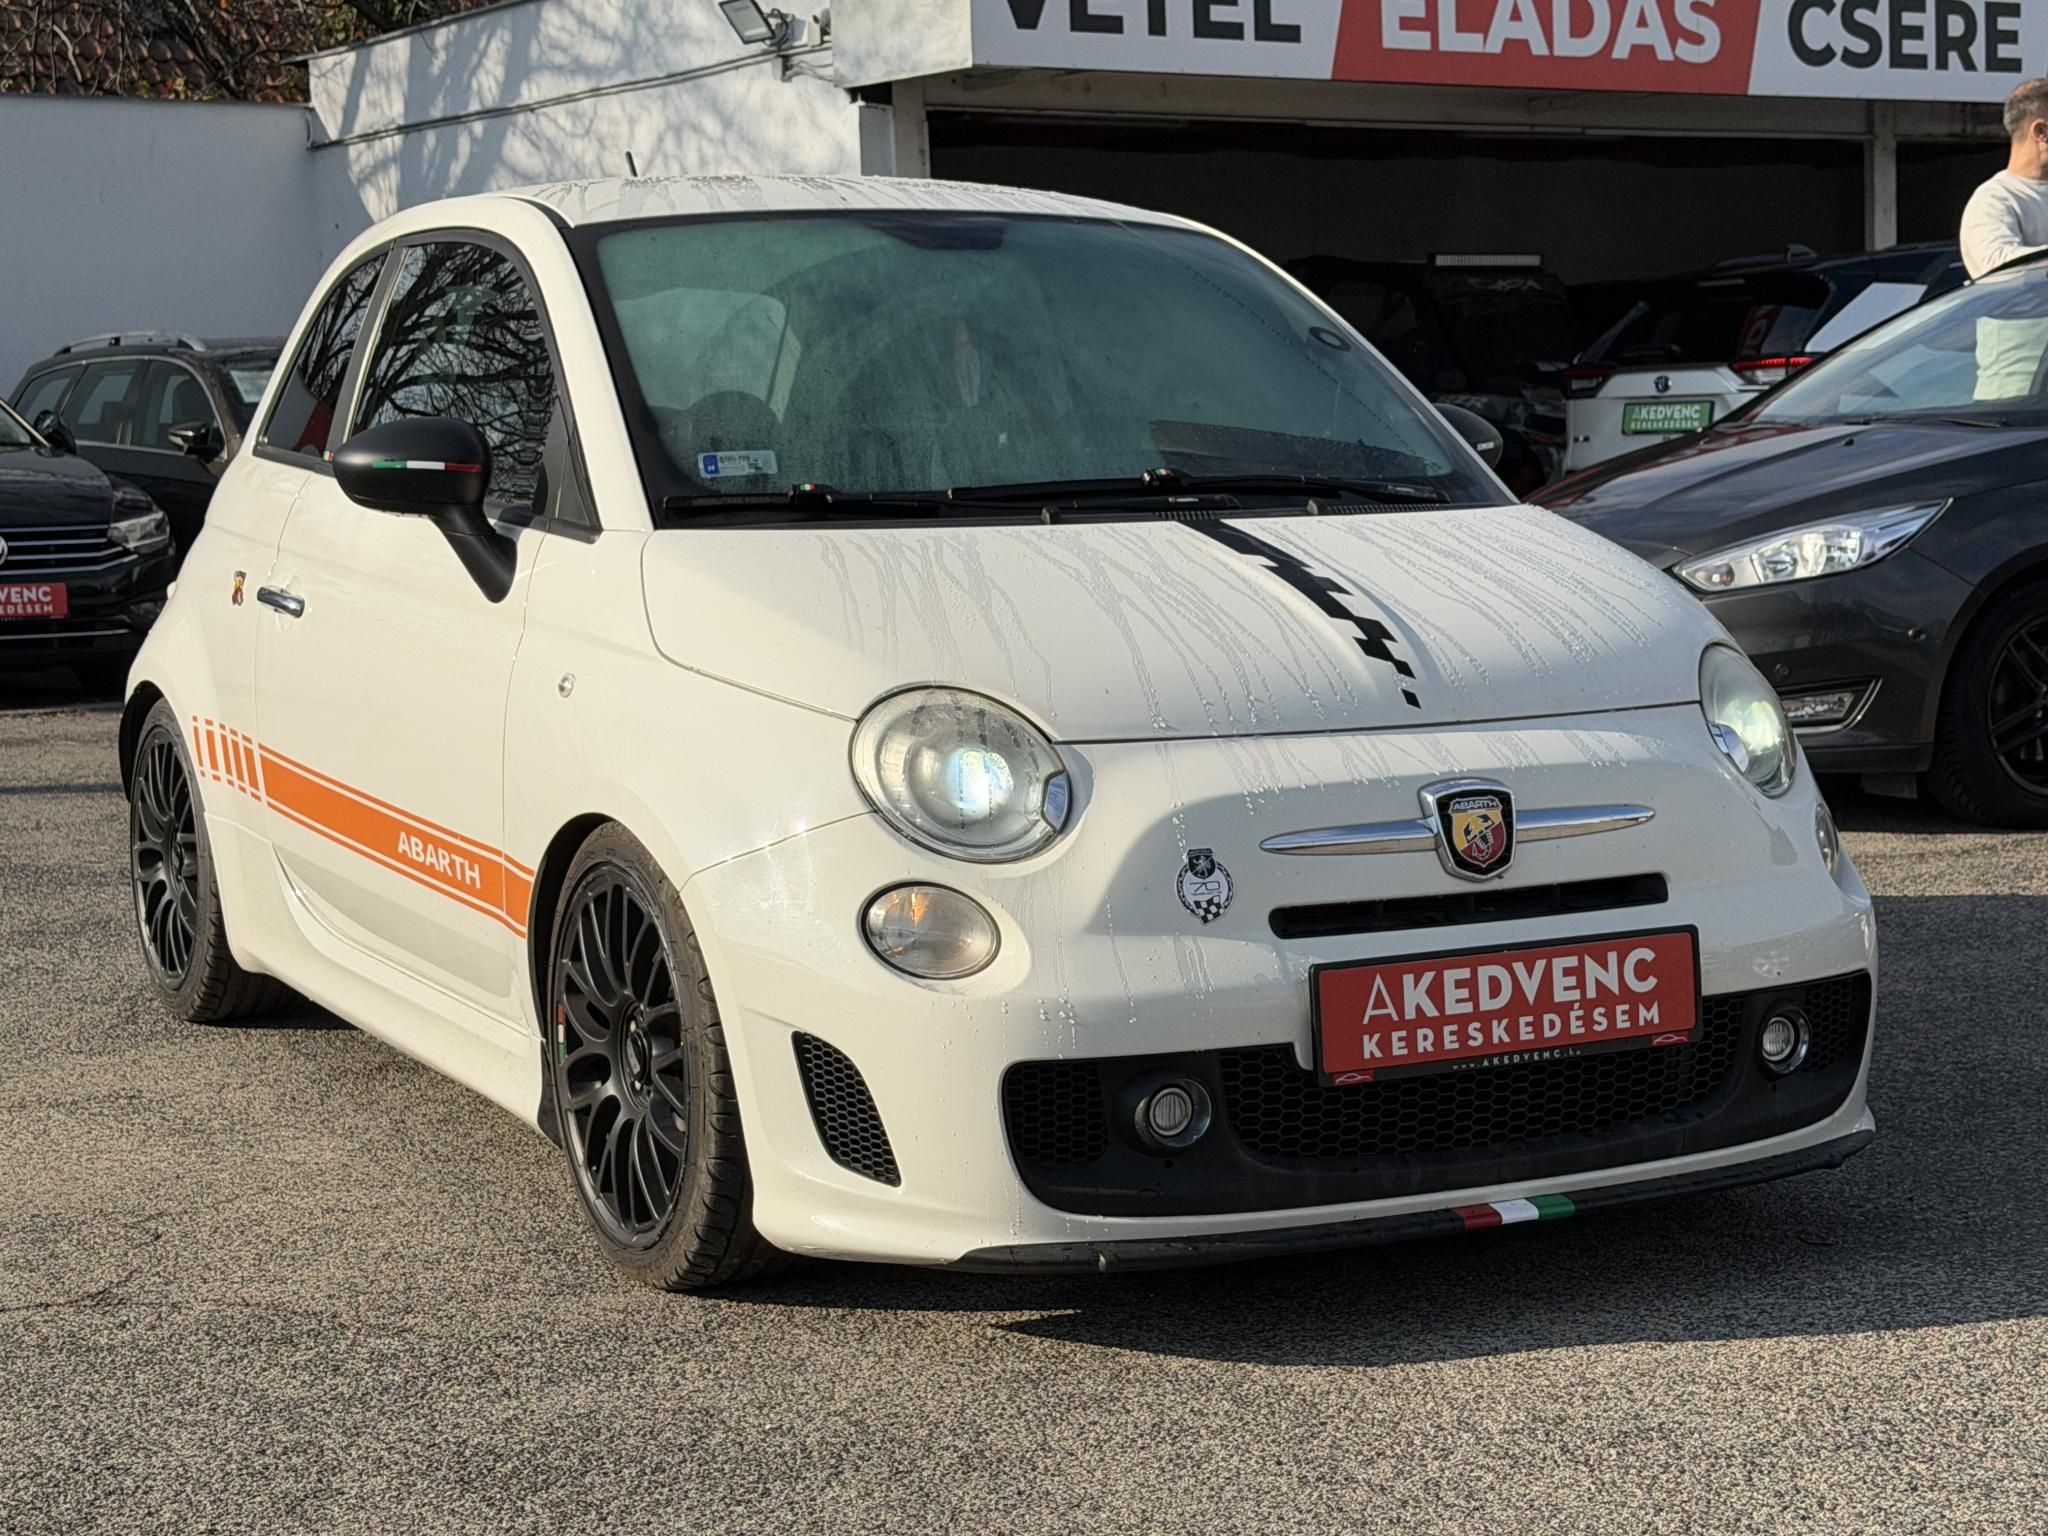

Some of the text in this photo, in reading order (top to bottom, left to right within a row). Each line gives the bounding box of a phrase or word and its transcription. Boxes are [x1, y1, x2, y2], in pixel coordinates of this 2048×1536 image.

[1787, 0, 2023, 74] CSERE
[1631, 404, 1702, 420] AKEDVENC
[1453, 800, 1497, 810] ABARTH
[398, 831, 481, 889] ABARTH
[1362, 947, 1659, 1025] AKEDVENC
[1362, 1001, 1661, 1059] KERESKEDÉSEM
